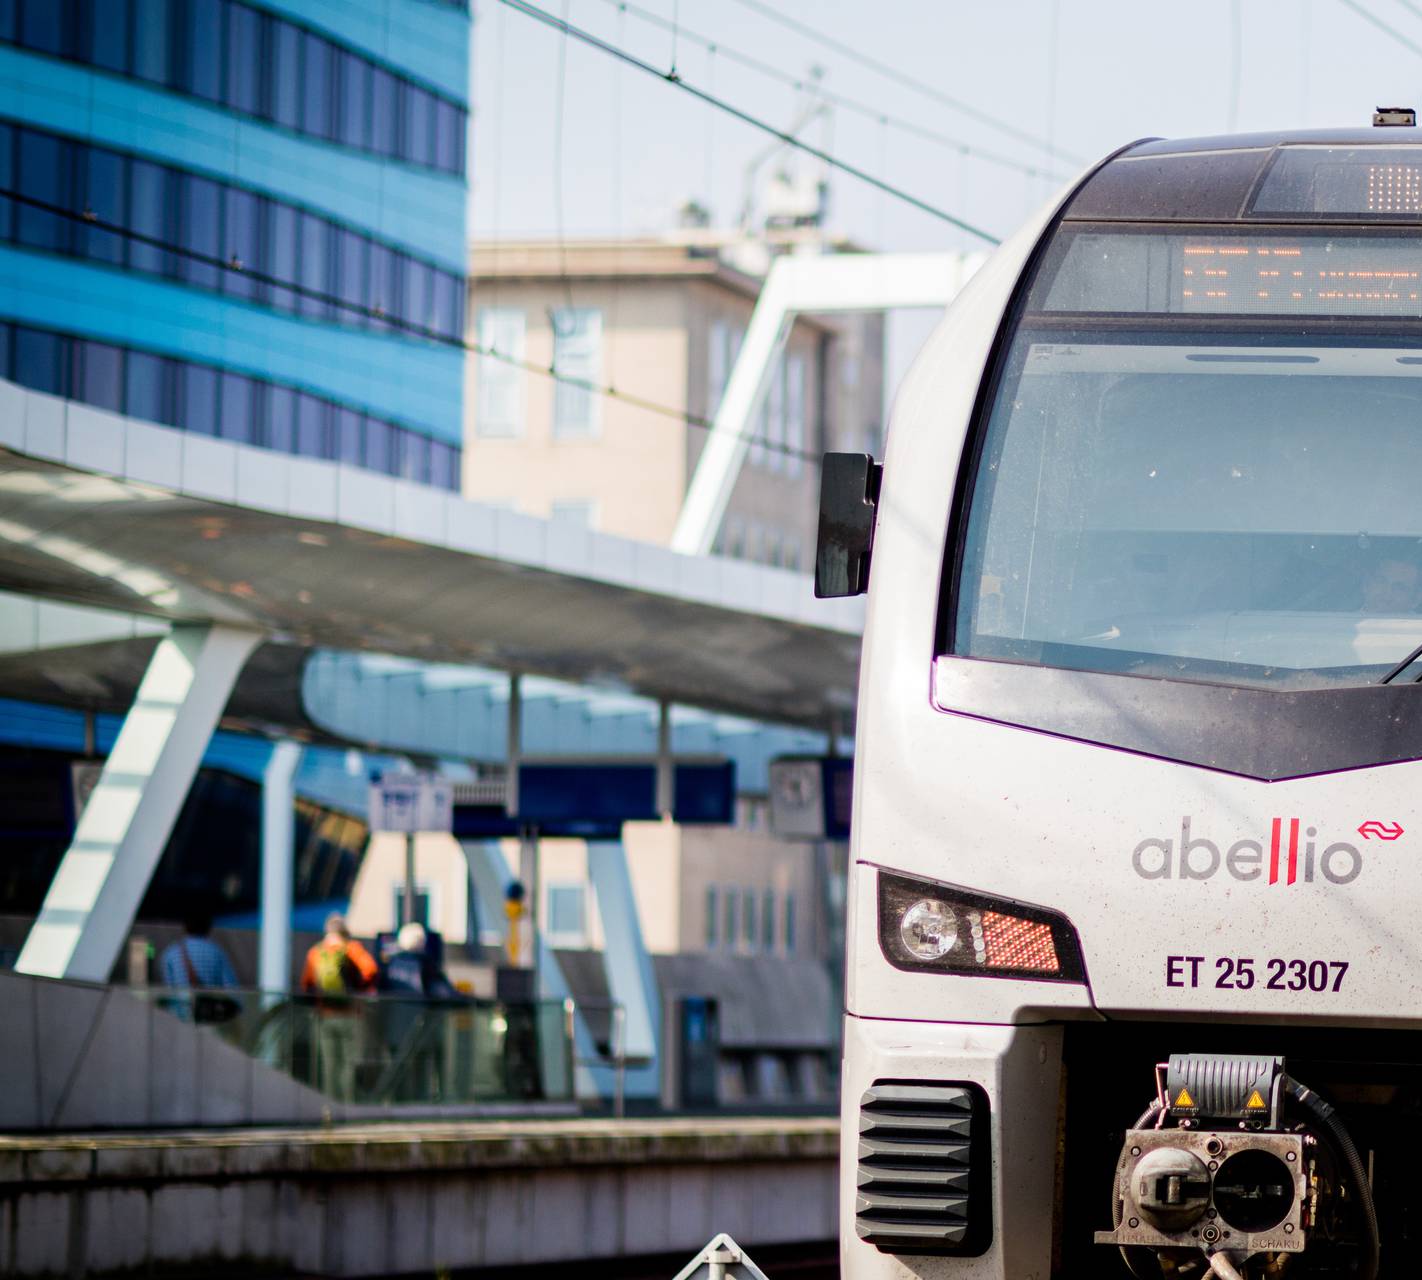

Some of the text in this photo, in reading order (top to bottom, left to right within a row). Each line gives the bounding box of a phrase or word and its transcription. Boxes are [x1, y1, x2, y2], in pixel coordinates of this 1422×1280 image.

[1131, 815, 1363, 886] abellio
[1166, 955, 1350, 993] ET 25 2307
